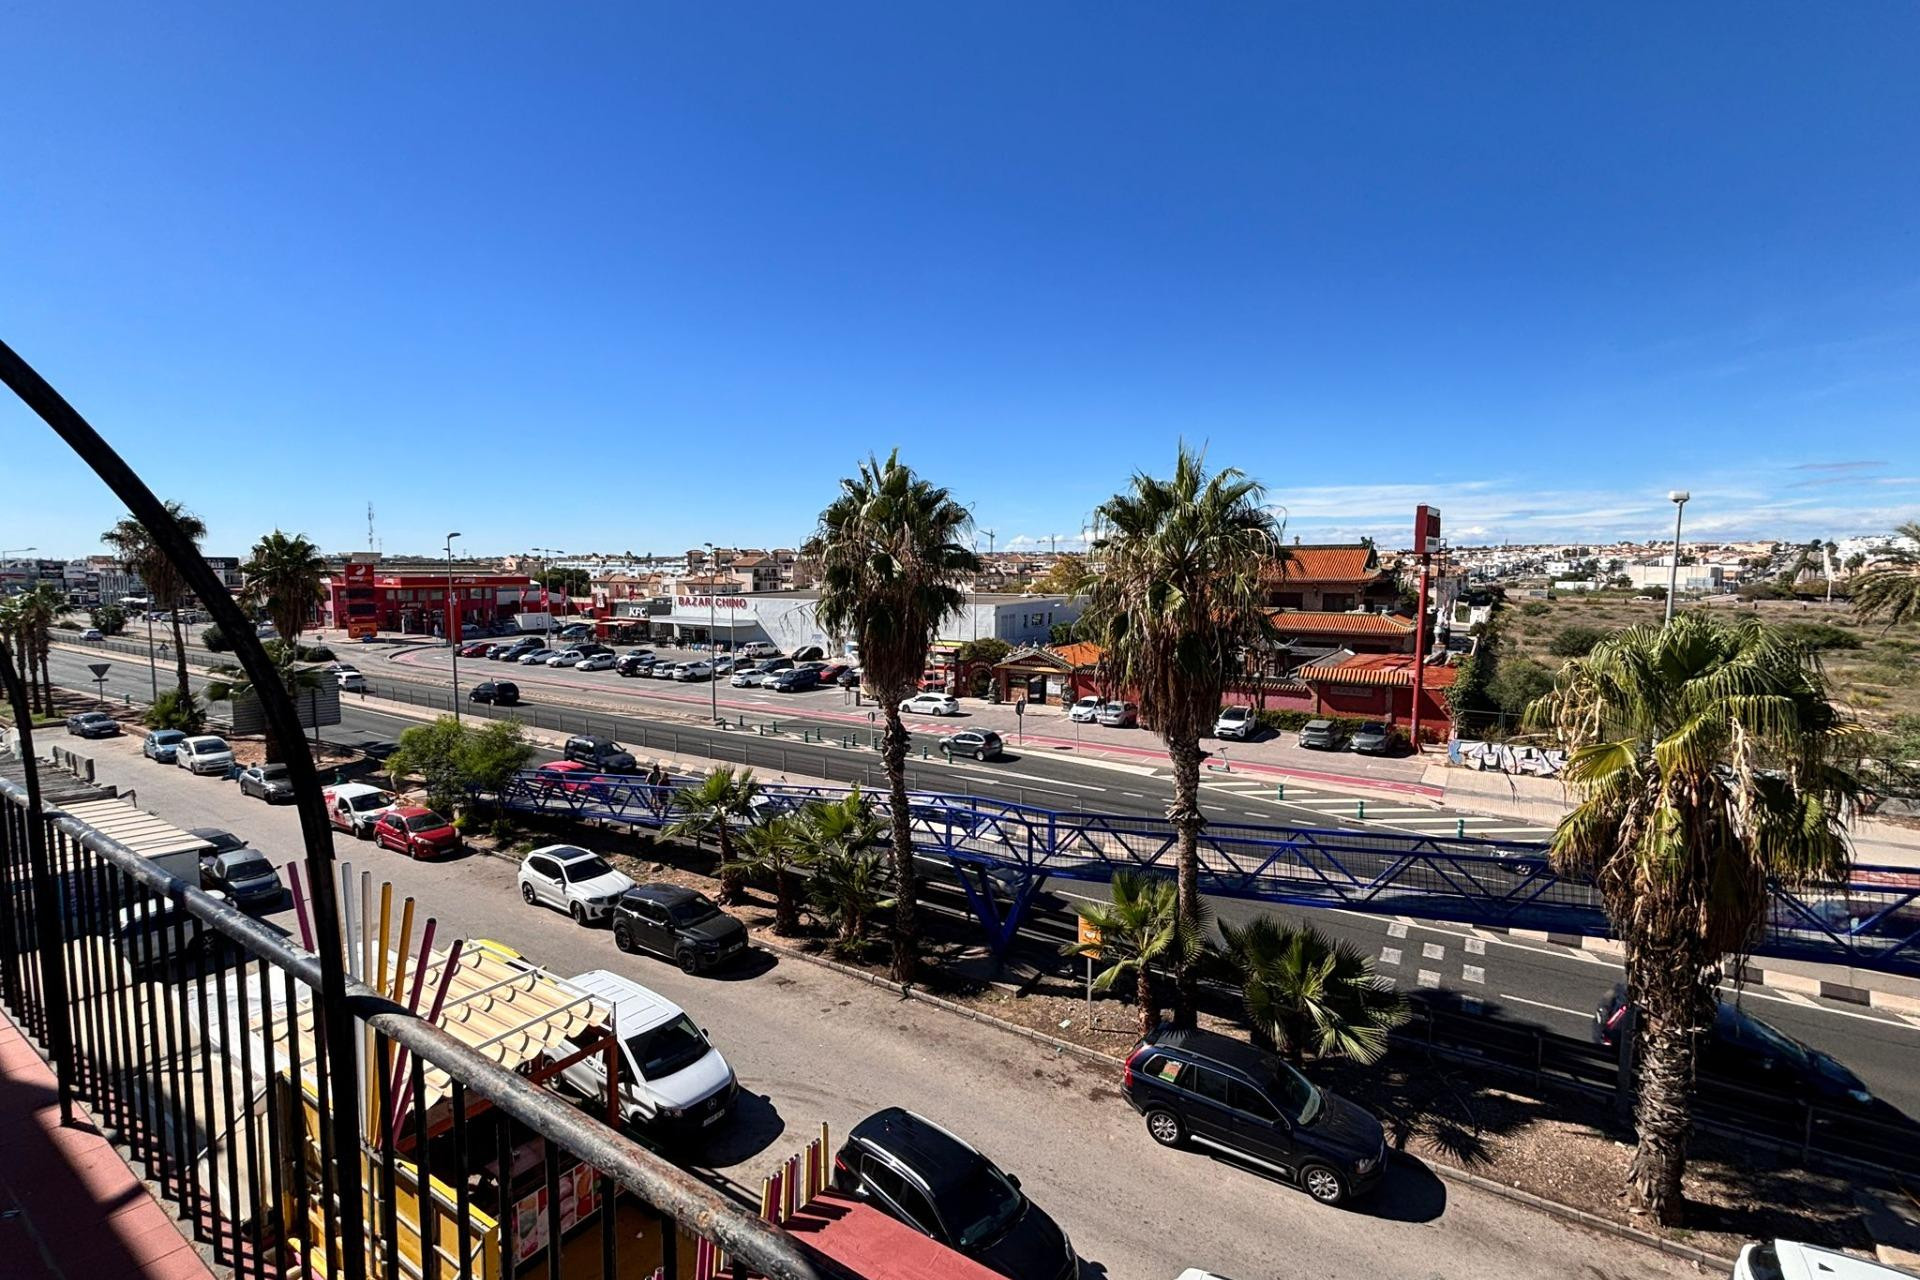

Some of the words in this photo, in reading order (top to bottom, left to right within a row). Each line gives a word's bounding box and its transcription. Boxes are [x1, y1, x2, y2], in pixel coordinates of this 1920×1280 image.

[678, 596, 711, 608] BAZAR
[715, 597, 747, 609] CHINO
[628, 607, 646, 617] KFC
